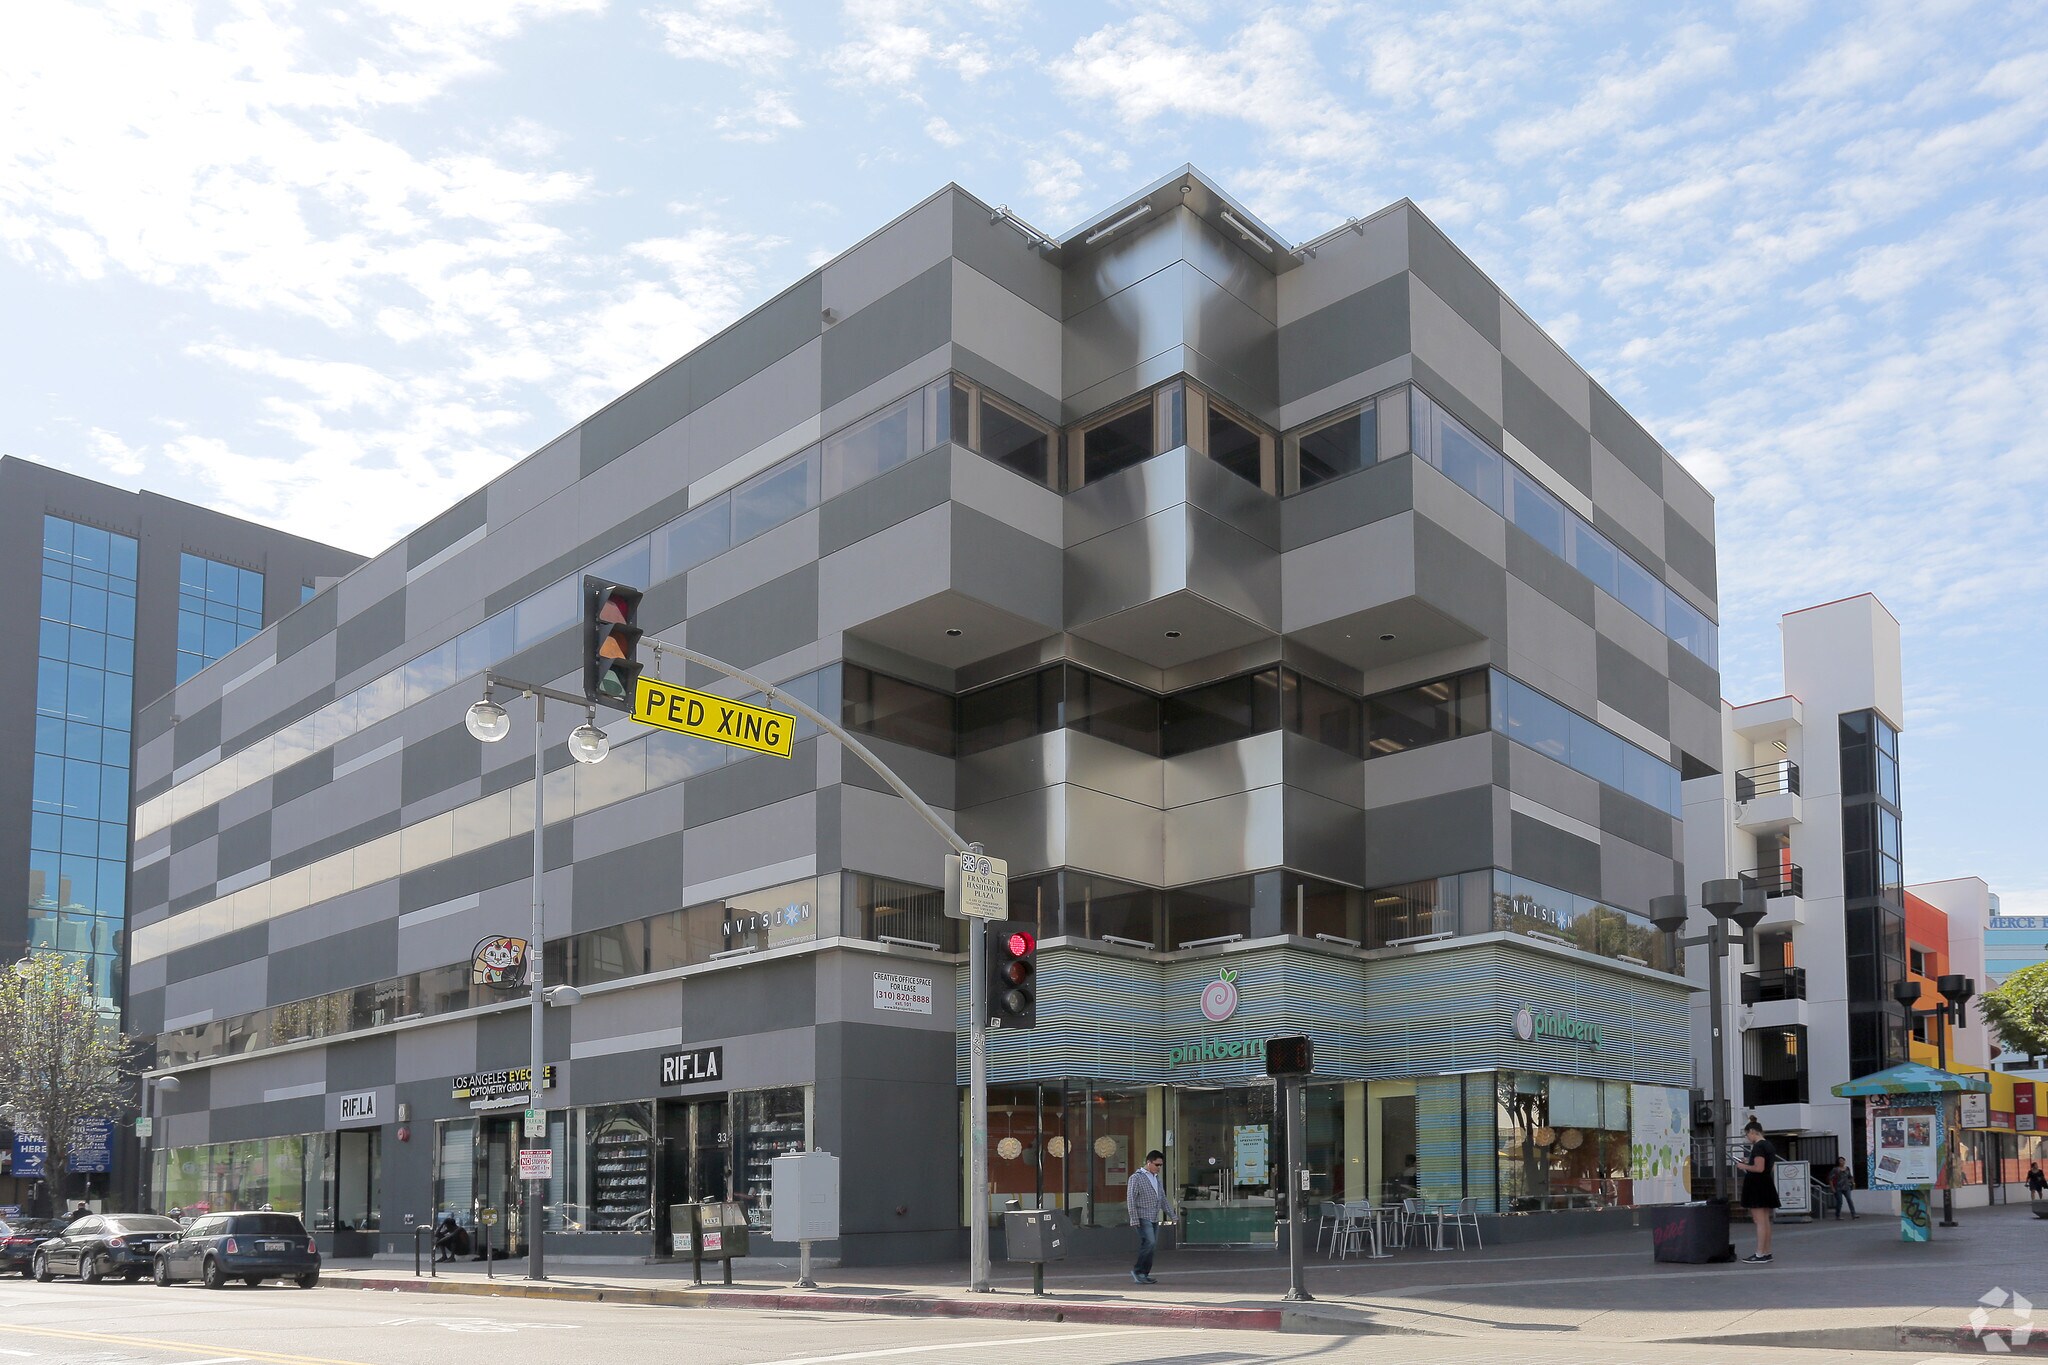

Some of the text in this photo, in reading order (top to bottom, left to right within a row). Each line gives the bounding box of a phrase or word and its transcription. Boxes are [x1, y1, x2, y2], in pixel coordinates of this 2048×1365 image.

[646, 689, 780, 746] PED XING
[967, 874, 996, 885] FRANCES
[966, 882, 1004, 894] HASHIMOTO
[974, 890, 994, 900] PLAZA
[874, 972, 931, 987] CREATIVE OFFICE SPACE
[890, 982, 916, 992] FOR LEASE
[876, 990, 930, 1004] (310) 820-8888
[1535, 1010, 1603, 1051] pinkberry
[1169, 1036, 1267, 1070] pinkberry
[663, 1051, 718, 1082] RIF.LA
[452, 1065, 551, 1089] LOS ANGELES EYECE
[470, 1081, 528, 1097] OPTOMETRY GROUP
[342, 1095, 373, 1118] RIF.LA
[18, 1135, 48, 1143] ENTE
[21, 1145, 47, 1153] HERE
